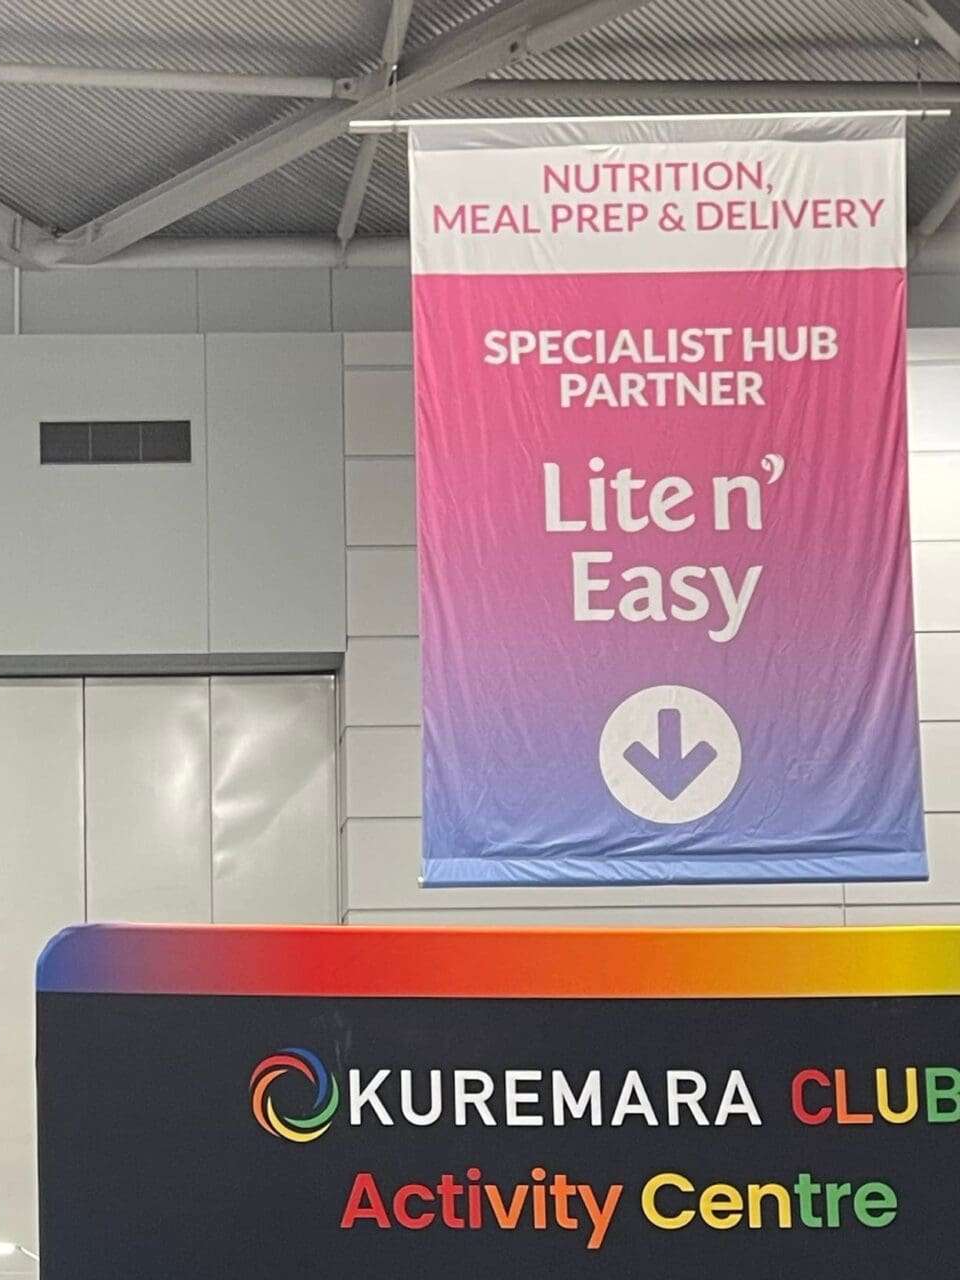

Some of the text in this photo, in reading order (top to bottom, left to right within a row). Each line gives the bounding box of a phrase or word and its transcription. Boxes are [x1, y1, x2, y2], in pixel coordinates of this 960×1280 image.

[543, 162, 774, 195] NUTRITION,
[434, 198, 886, 235] MEAL PREP & DELIVERY
[483, 326, 839, 366] SPECIALIST HUB
[559, 371, 766, 409] PARTNER
[543, 455, 696, 534] Lite
[571, 550, 764, 644] Easy
[349, 1067, 960, 1127] KUREMARA CLUB
[340, 1167, 899, 1250] Activity Centre
